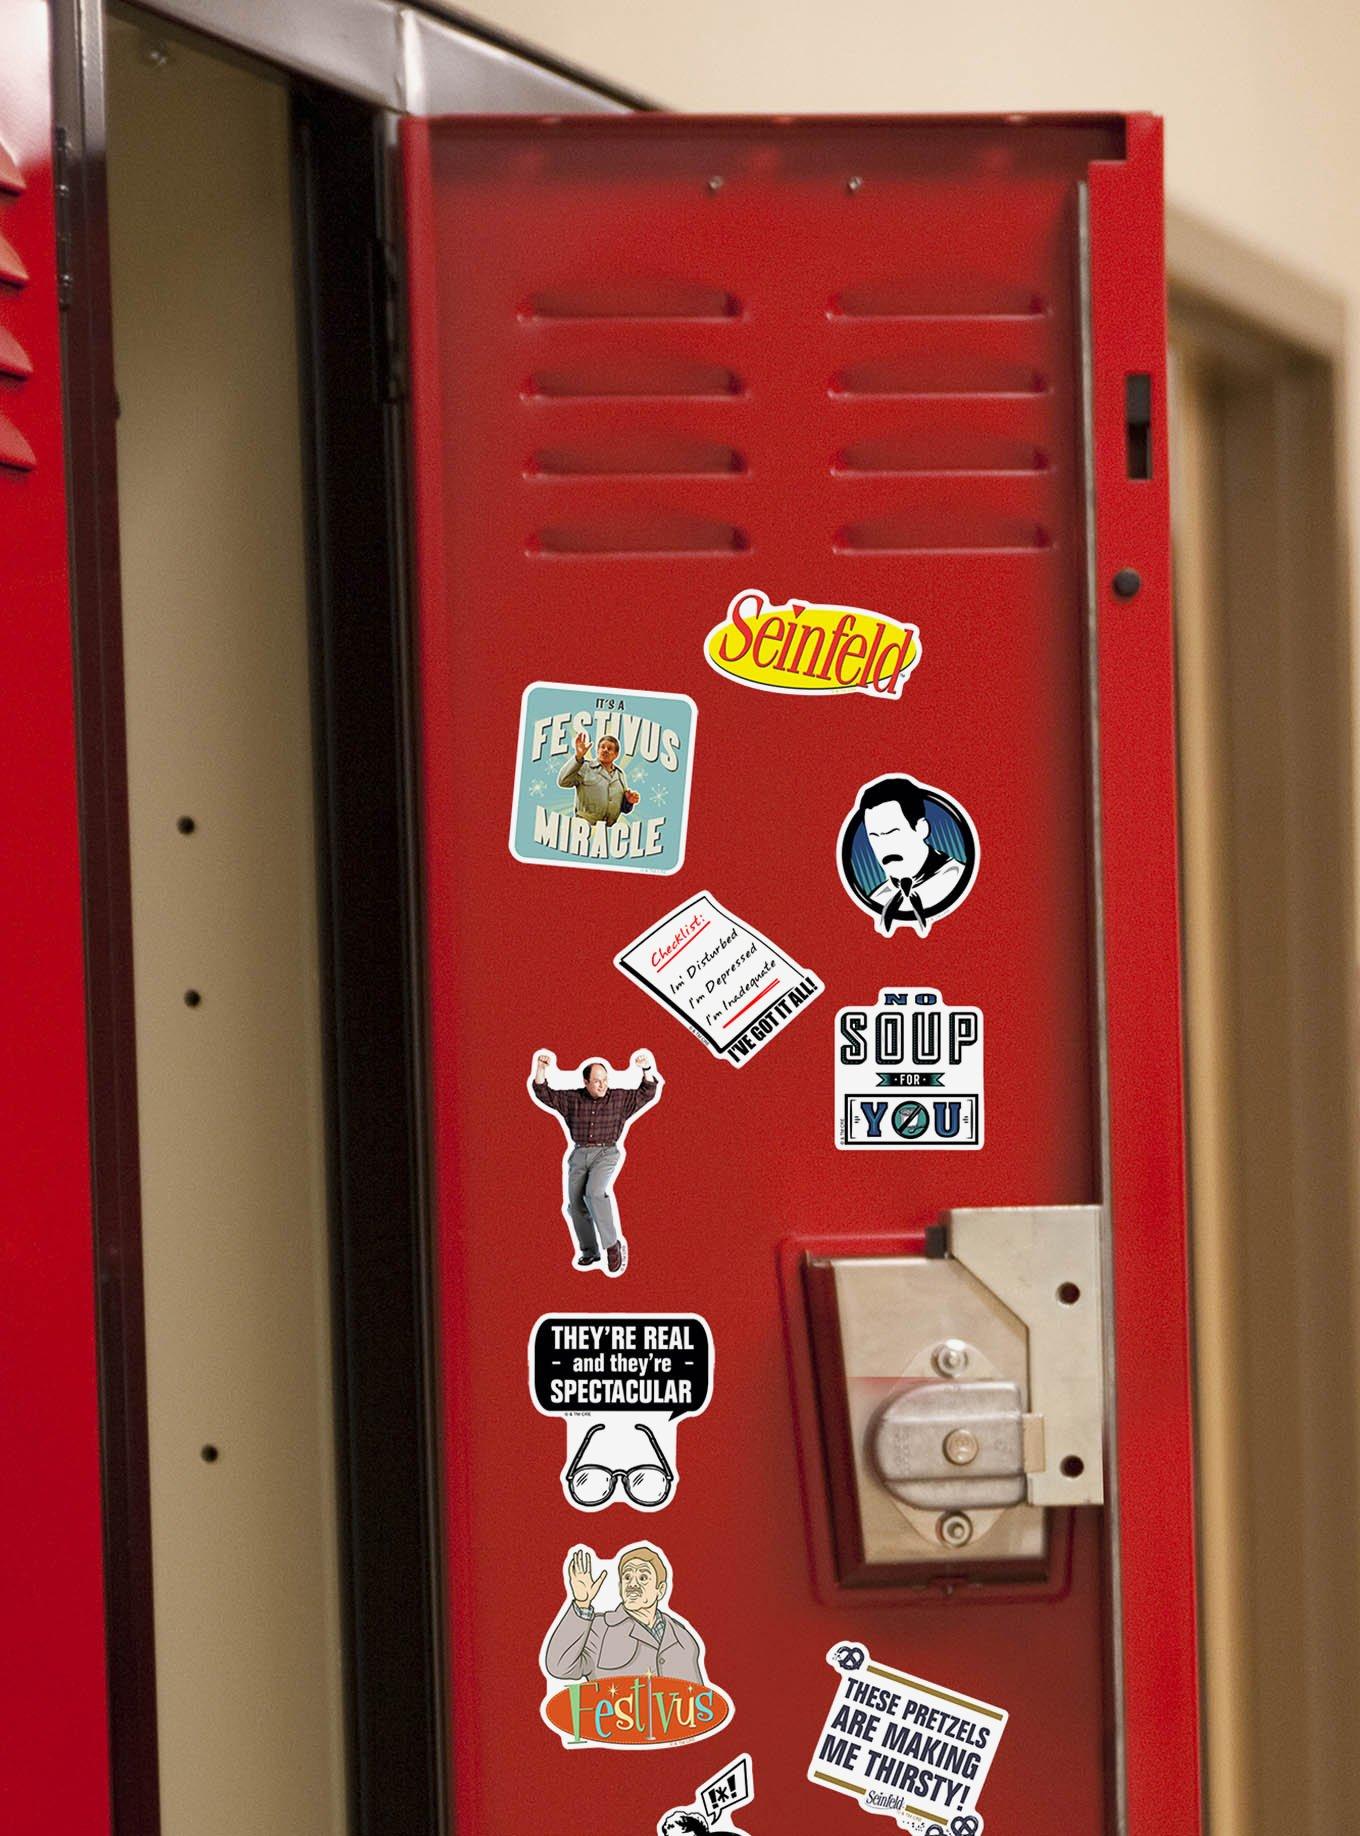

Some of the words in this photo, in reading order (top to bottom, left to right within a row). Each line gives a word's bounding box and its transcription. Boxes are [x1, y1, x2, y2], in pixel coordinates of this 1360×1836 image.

[718, 595, 912, 694] Seinfeld
[596, 698, 615, 709] IT'S
[618, 699, 625, 710] A
[532, 711, 681, 773] FESTIVUS
[533, 805, 667, 859] MIRACLE
[651, 914, 706, 967] Checklist:
[686, 928, 739, 979] Disturbed
[688, 994, 706, 1009] I'm
[705, 942, 758, 993] Depressed
[705, 1011, 722, 1026] I'm
[722, 958, 777, 1011] Inadequate
[884, 993, 938, 1006] NO
[727, 1034, 756, 1063] I'VE
[755, 1011, 780, 1041] GOT
[774, 1000, 793, 1020] IT
[790, 976, 818, 1006] ALL!
[840, 1011, 978, 1065] SOUP
[899, 1074, 920, 1086] FOR
[860, 1100, 962, 1140] YOU
[551, 1325, 637, 1350] THEY'RE
[643, 1325, 694, 1350] REAL
[550, 1379, 692, 1404] SPECTACULAR
[572, 1353, 605, 1373] and
[609, 1353, 672, 1377] they're
[844, 1677, 901, 1716] THESE
[901, 1699, 990, 1749] PRETZELS
[831, 1704, 881, 1743] ARE
[881, 1722, 982, 1780] MAKING
[818, 1733, 862, 1771] ME
[864, 1750, 970, 1811] THIRSTY!
[865, 1789, 905, 1811] Seinfeld
